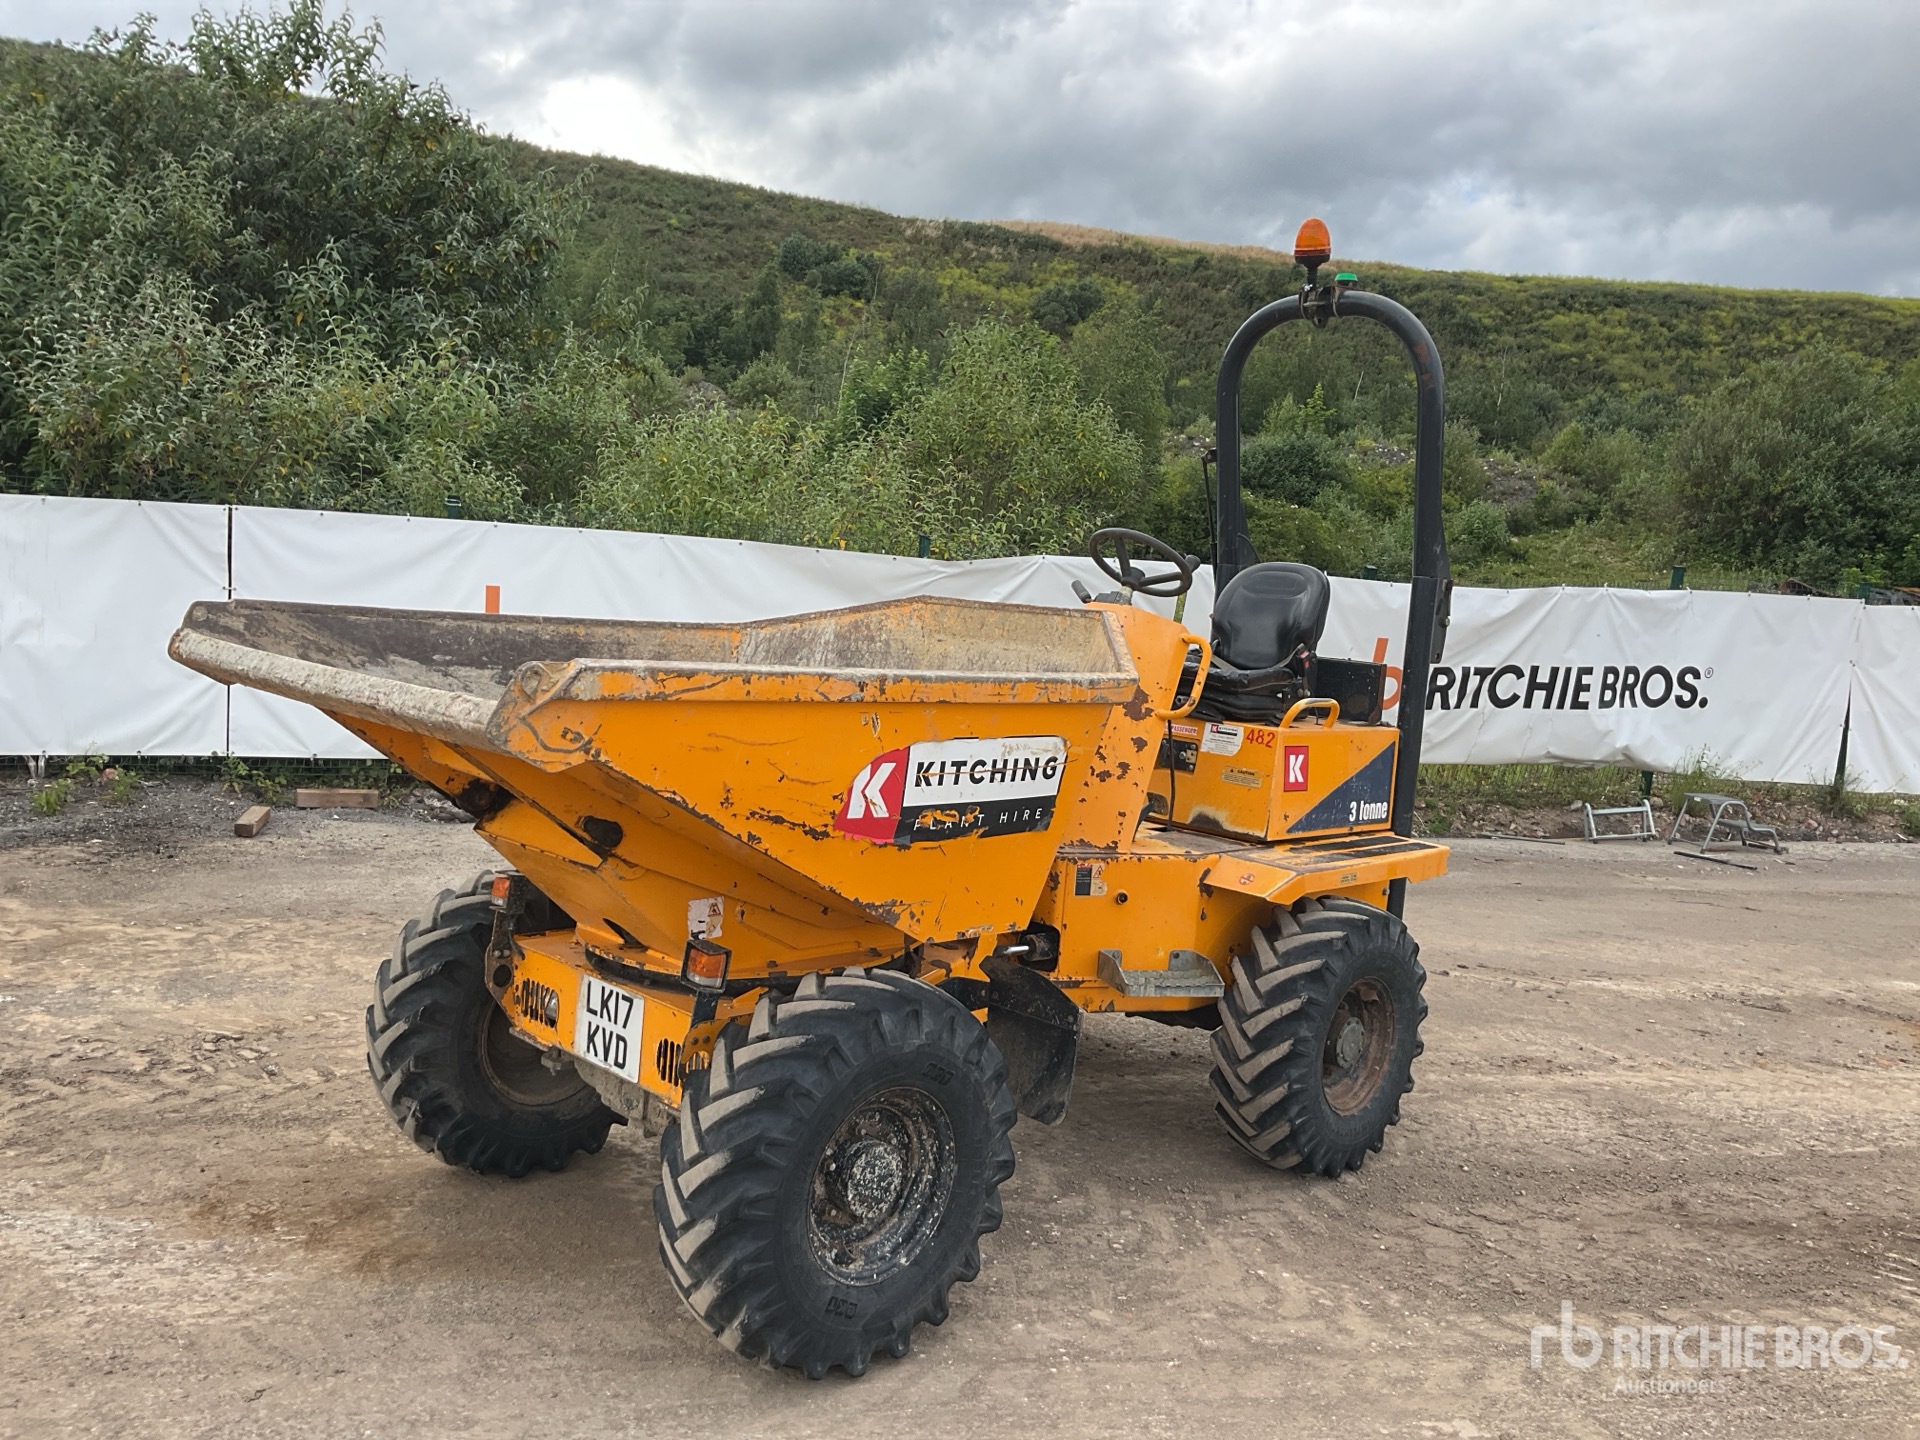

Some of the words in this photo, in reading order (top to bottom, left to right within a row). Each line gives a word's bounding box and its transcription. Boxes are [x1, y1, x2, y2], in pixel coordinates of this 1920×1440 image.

[1426, 664, 1594, 710] RITCHIE
[914, 755, 1059, 788] KITCHING
[1288, 753, 1305, 783] K
[847, 762, 896, 819] K
[999, 808, 1043, 824] HIRE
[1349, 801, 1356, 822] 3
[1359, 801, 1388, 821] tonne
[586, 980, 634, 1029] LK17
[586, 1020, 628, 1070] KVD
